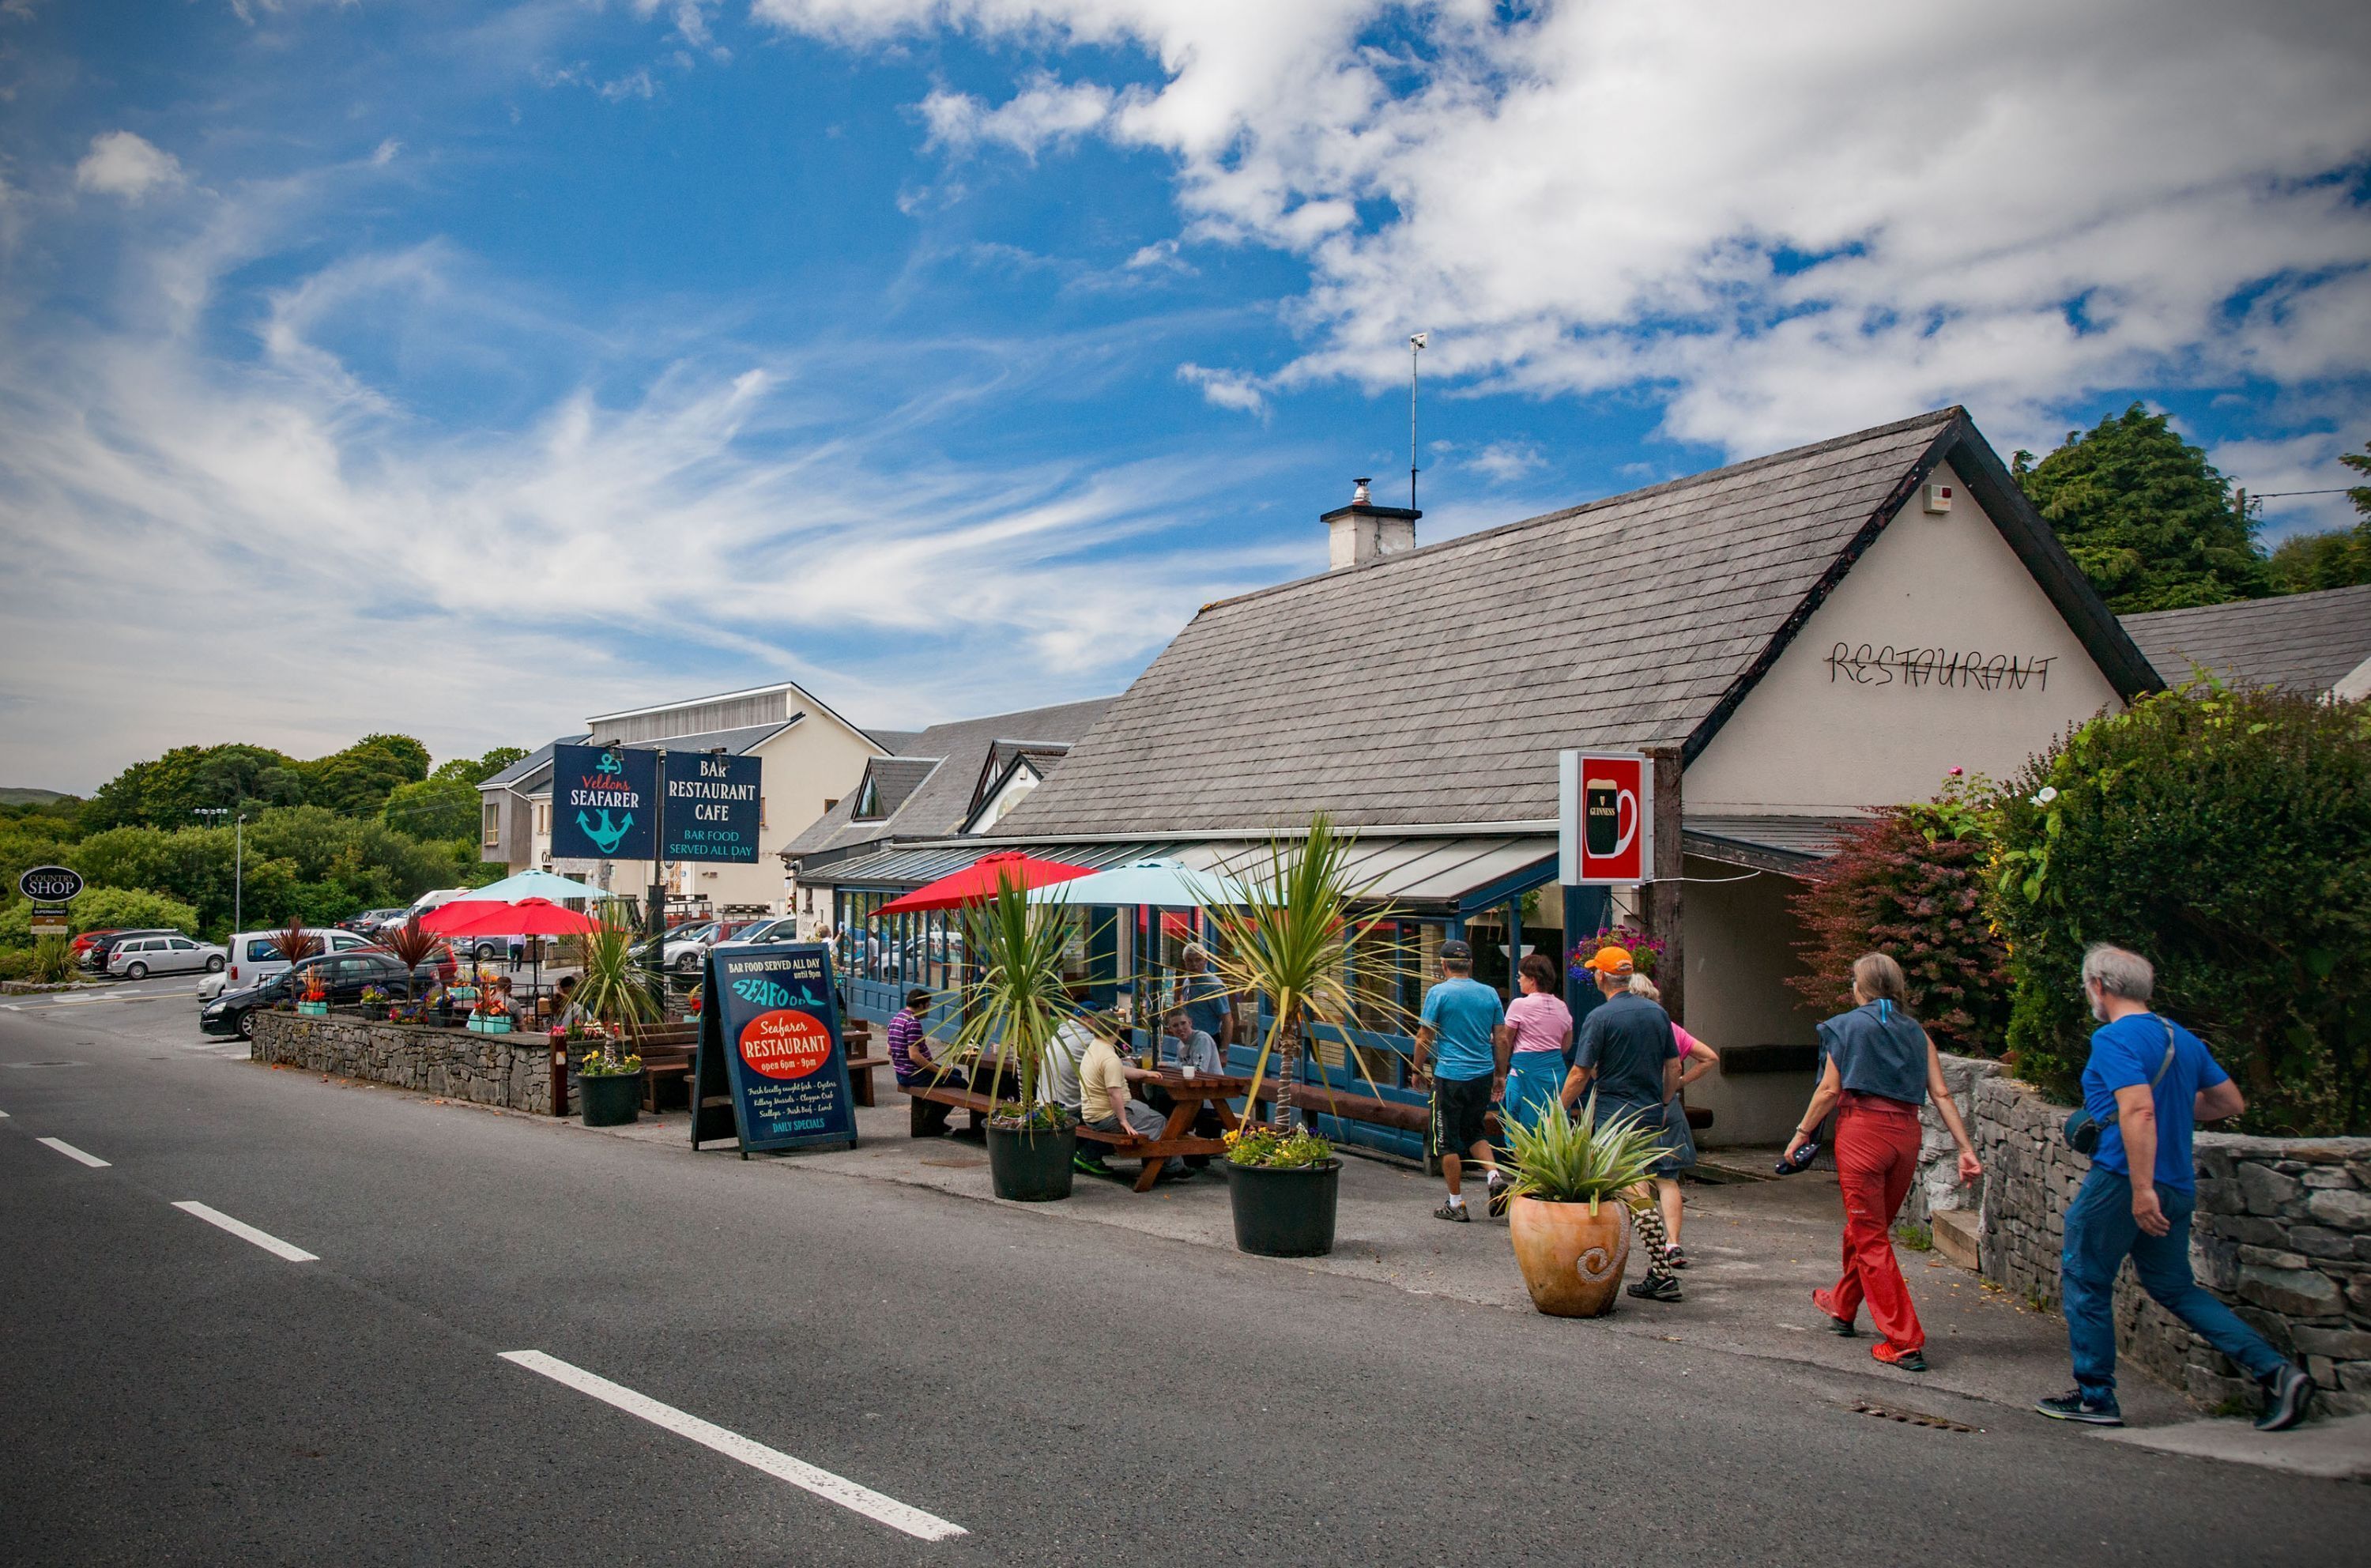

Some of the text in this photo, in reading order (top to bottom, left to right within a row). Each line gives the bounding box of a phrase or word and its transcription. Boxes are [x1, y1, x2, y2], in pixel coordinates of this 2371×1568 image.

[1823, 643, 2058, 692] RESTAURANT
[700, 760, 726, 778] BAR
[582, 774, 631, 790] Veldons
[669, 781, 756, 801] RESTAURANT
[571, 790, 639, 808] SEAFARER
[695, 804, 729, 821] CAFE
[1589, 807, 1615, 816] GUINNESS
[684, 830, 739, 842] BAR FOOD
[669, 843, 708, 854] SERVED
[710, 845, 729, 855] ALL
[731, 846, 752, 857] DAY
[28, 874, 74, 883] COUNTRY
[28, 881, 74, 894] SHOP
[729, 958, 820, 973] BAR FOOD SERVED ALL DAY
[793, 970, 821, 980] until 9pm
[760, 1017, 808, 1037] Seafarer
[745, 1035, 825, 1058] RESTAURANT
[761, 1062, 778, 1072] open
[780, 1060, 795, 1071] 6pm
[801, 1057, 816, 1069] 9pm
[748, 1086, 763, 1095] Fresh
[763, 1085, 782, 1095] locally
[782, 1083, 801, 1093] caught
[801, 1081, 812, 1091] fish
[817, 1080, 837, 1090] Oysters
[754, 1098, 772, 1107] Killary
[774, 1095, 795, 1105] Mussels
[800, 1094, 820, 1103] Cleggan
[821, 1091, 834, 1099] Crab
[760, 1109, 782, 1120] Scallops
[786, 1105, 801, 1115] Irish
[801, 1104, 812, 1114] Beef
[818, 1102, 833, 1112] Lamb
[772, 1118, 825, 1133] DAILY SPECIALS
